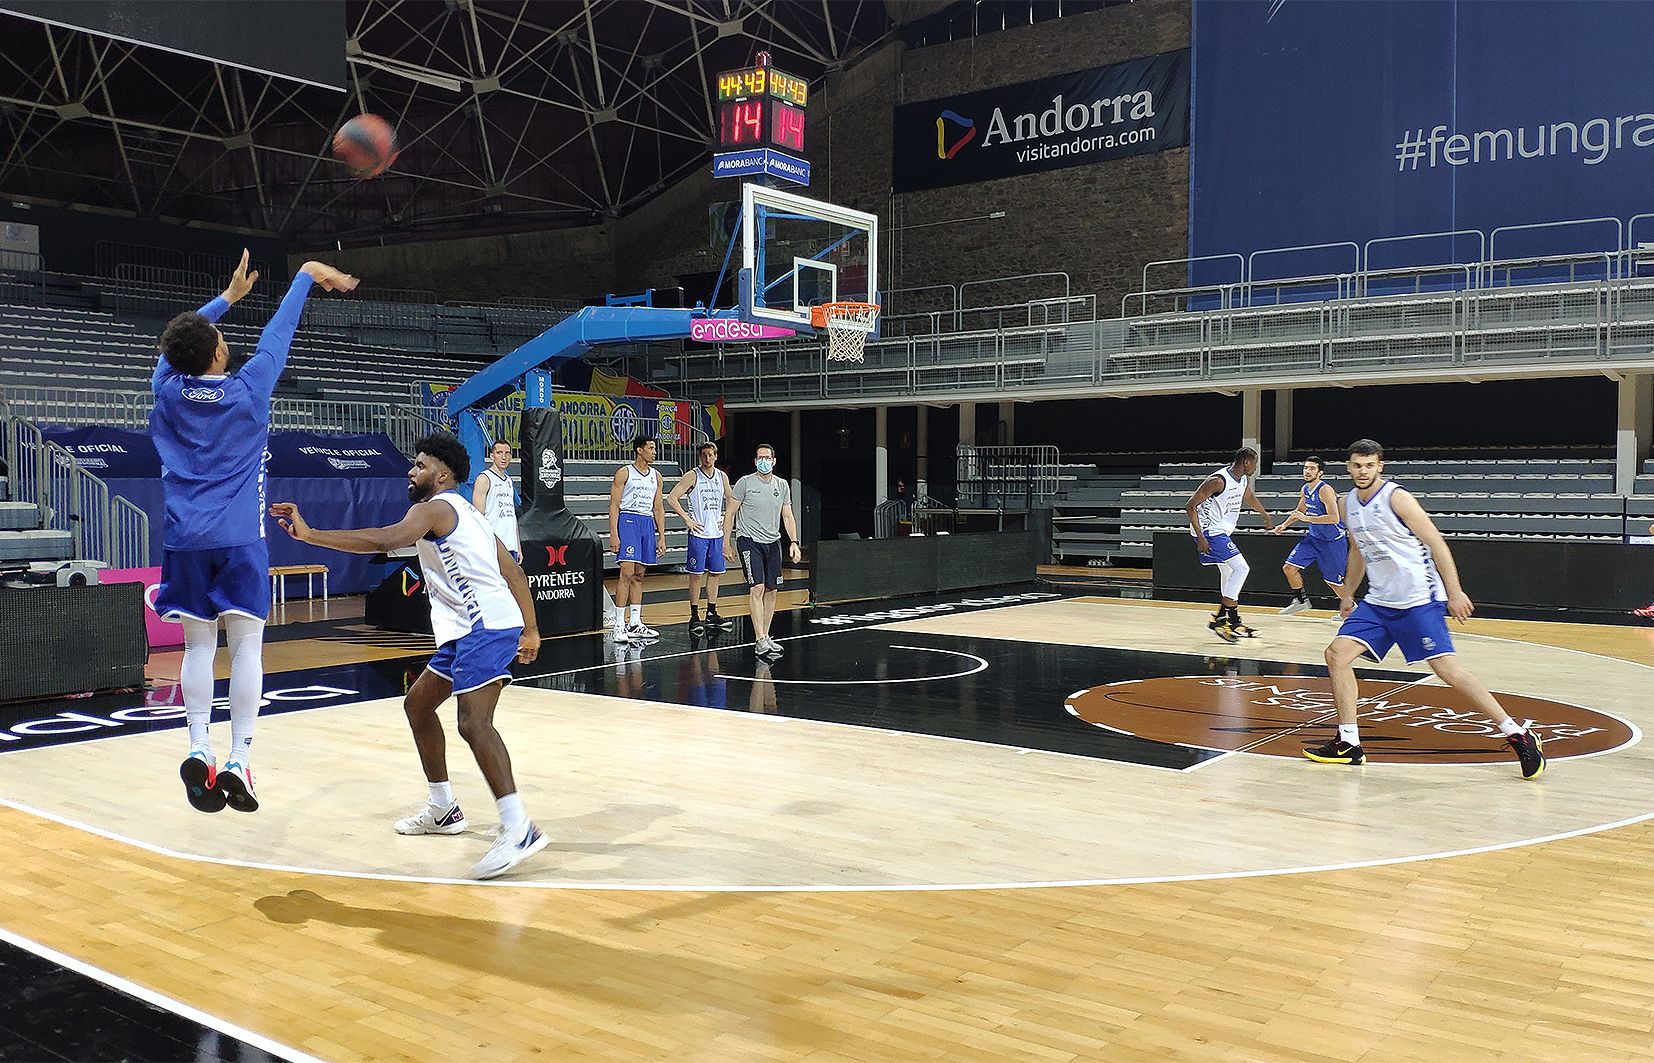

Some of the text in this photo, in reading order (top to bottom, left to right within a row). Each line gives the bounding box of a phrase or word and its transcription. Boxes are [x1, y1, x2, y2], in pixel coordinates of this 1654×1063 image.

[720, 68, 766, 97] 44:43
[770, 70, 807, 105] 44:43
[733, 101, 762, 143] 14
[779, 107, 805, 150] 14
[981, 89, 1156, 147] Andorra
[1016, 127, 1156, 163] visitandorra.com
[1395, 112, 1654, 171] #femungra
[724, 157, 763, 169] MORABANC
[692, 319, 763, 339] endesa
[559, 400, 607, 416] ANDORRA
[655, 404, 678, 413] FORÇA
[77, 443, 128, 454] OFICIAL
[342, 448, 382, 457] OFICIAL
[536, 588, 576, 601] ANDORRA
